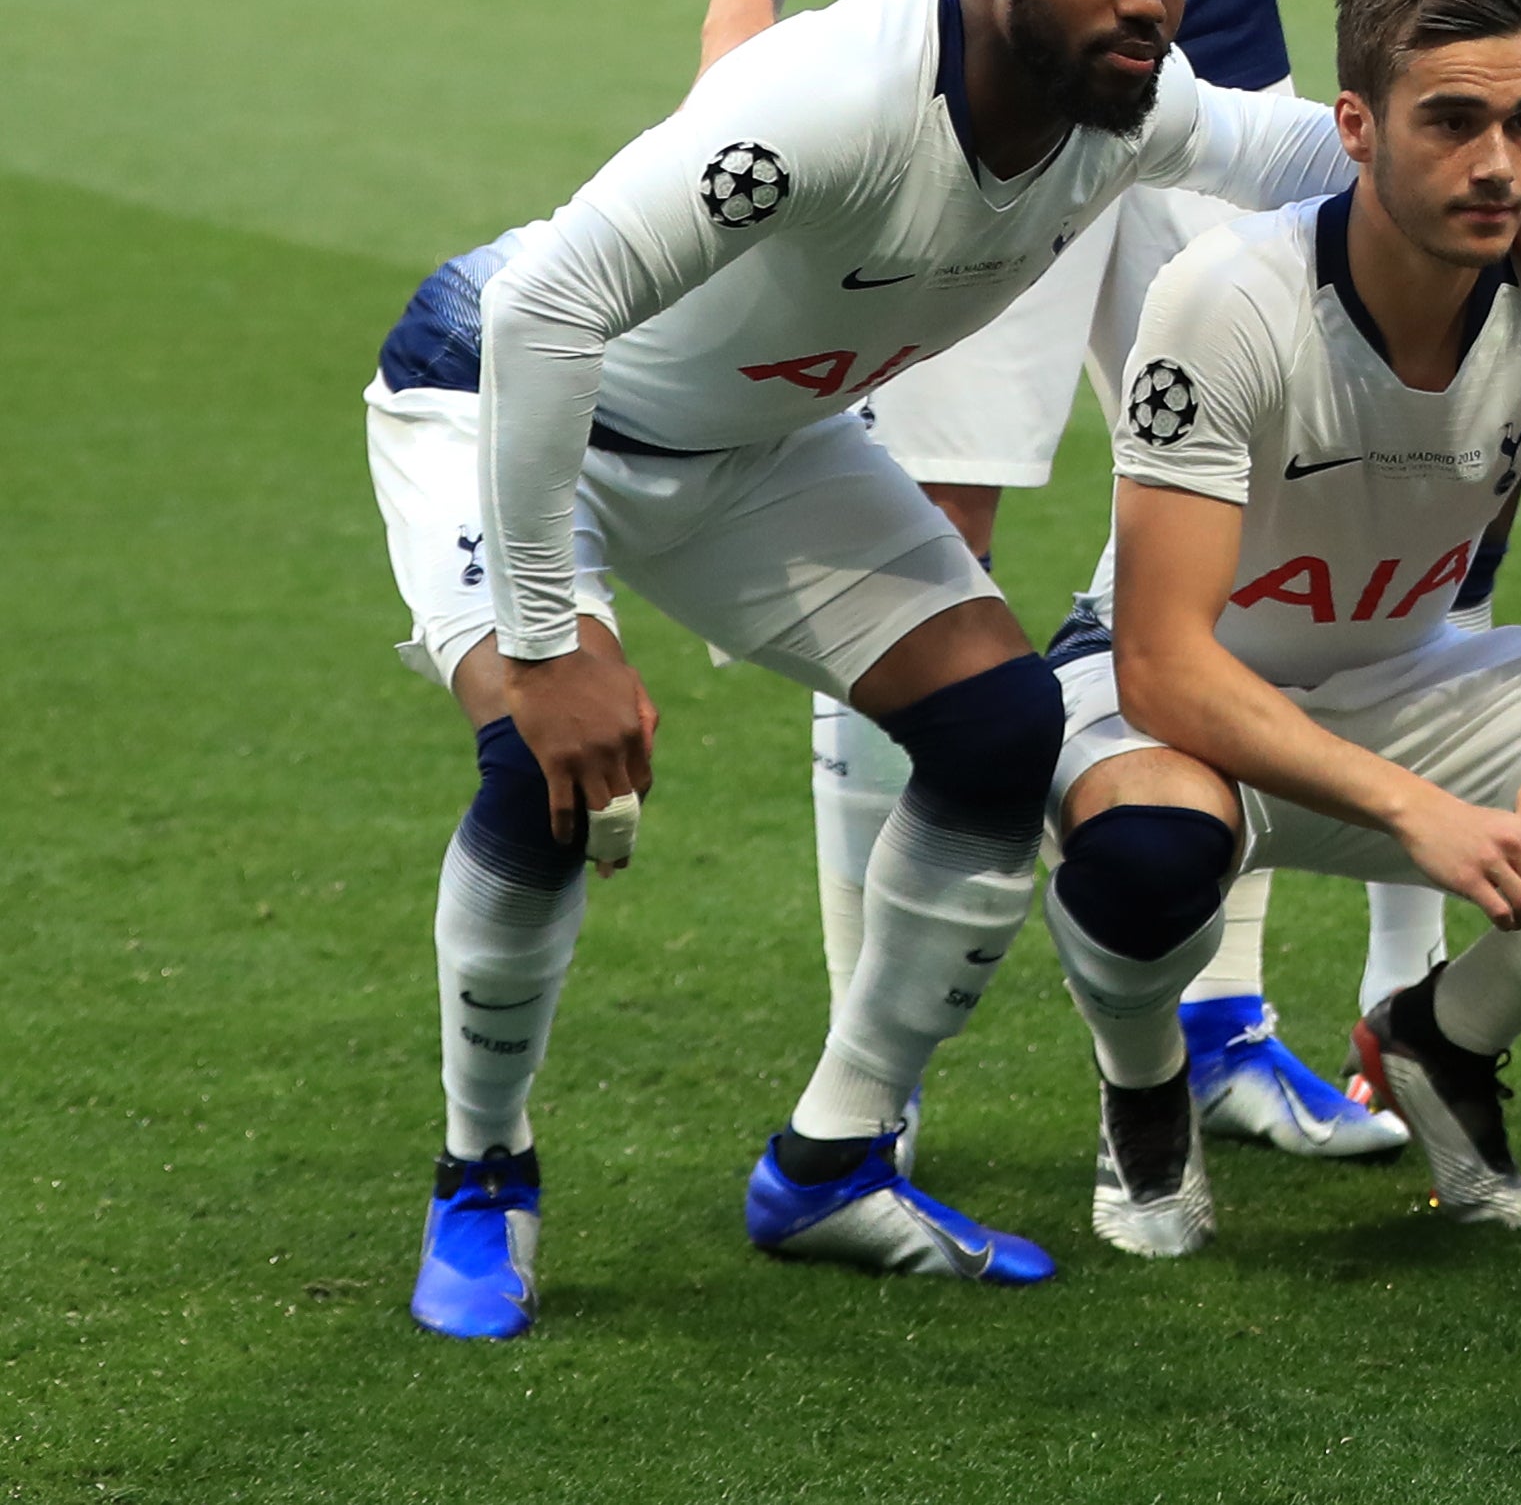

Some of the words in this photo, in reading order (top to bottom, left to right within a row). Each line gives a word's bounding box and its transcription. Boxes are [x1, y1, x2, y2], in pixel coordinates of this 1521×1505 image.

[1369, 451, 1404, 464] FINAL
[1407, 452, 1455, 465] MADRID
[1457, 450, 1481, 465] 2019
[1229, 539, 1473, 624] AIA
